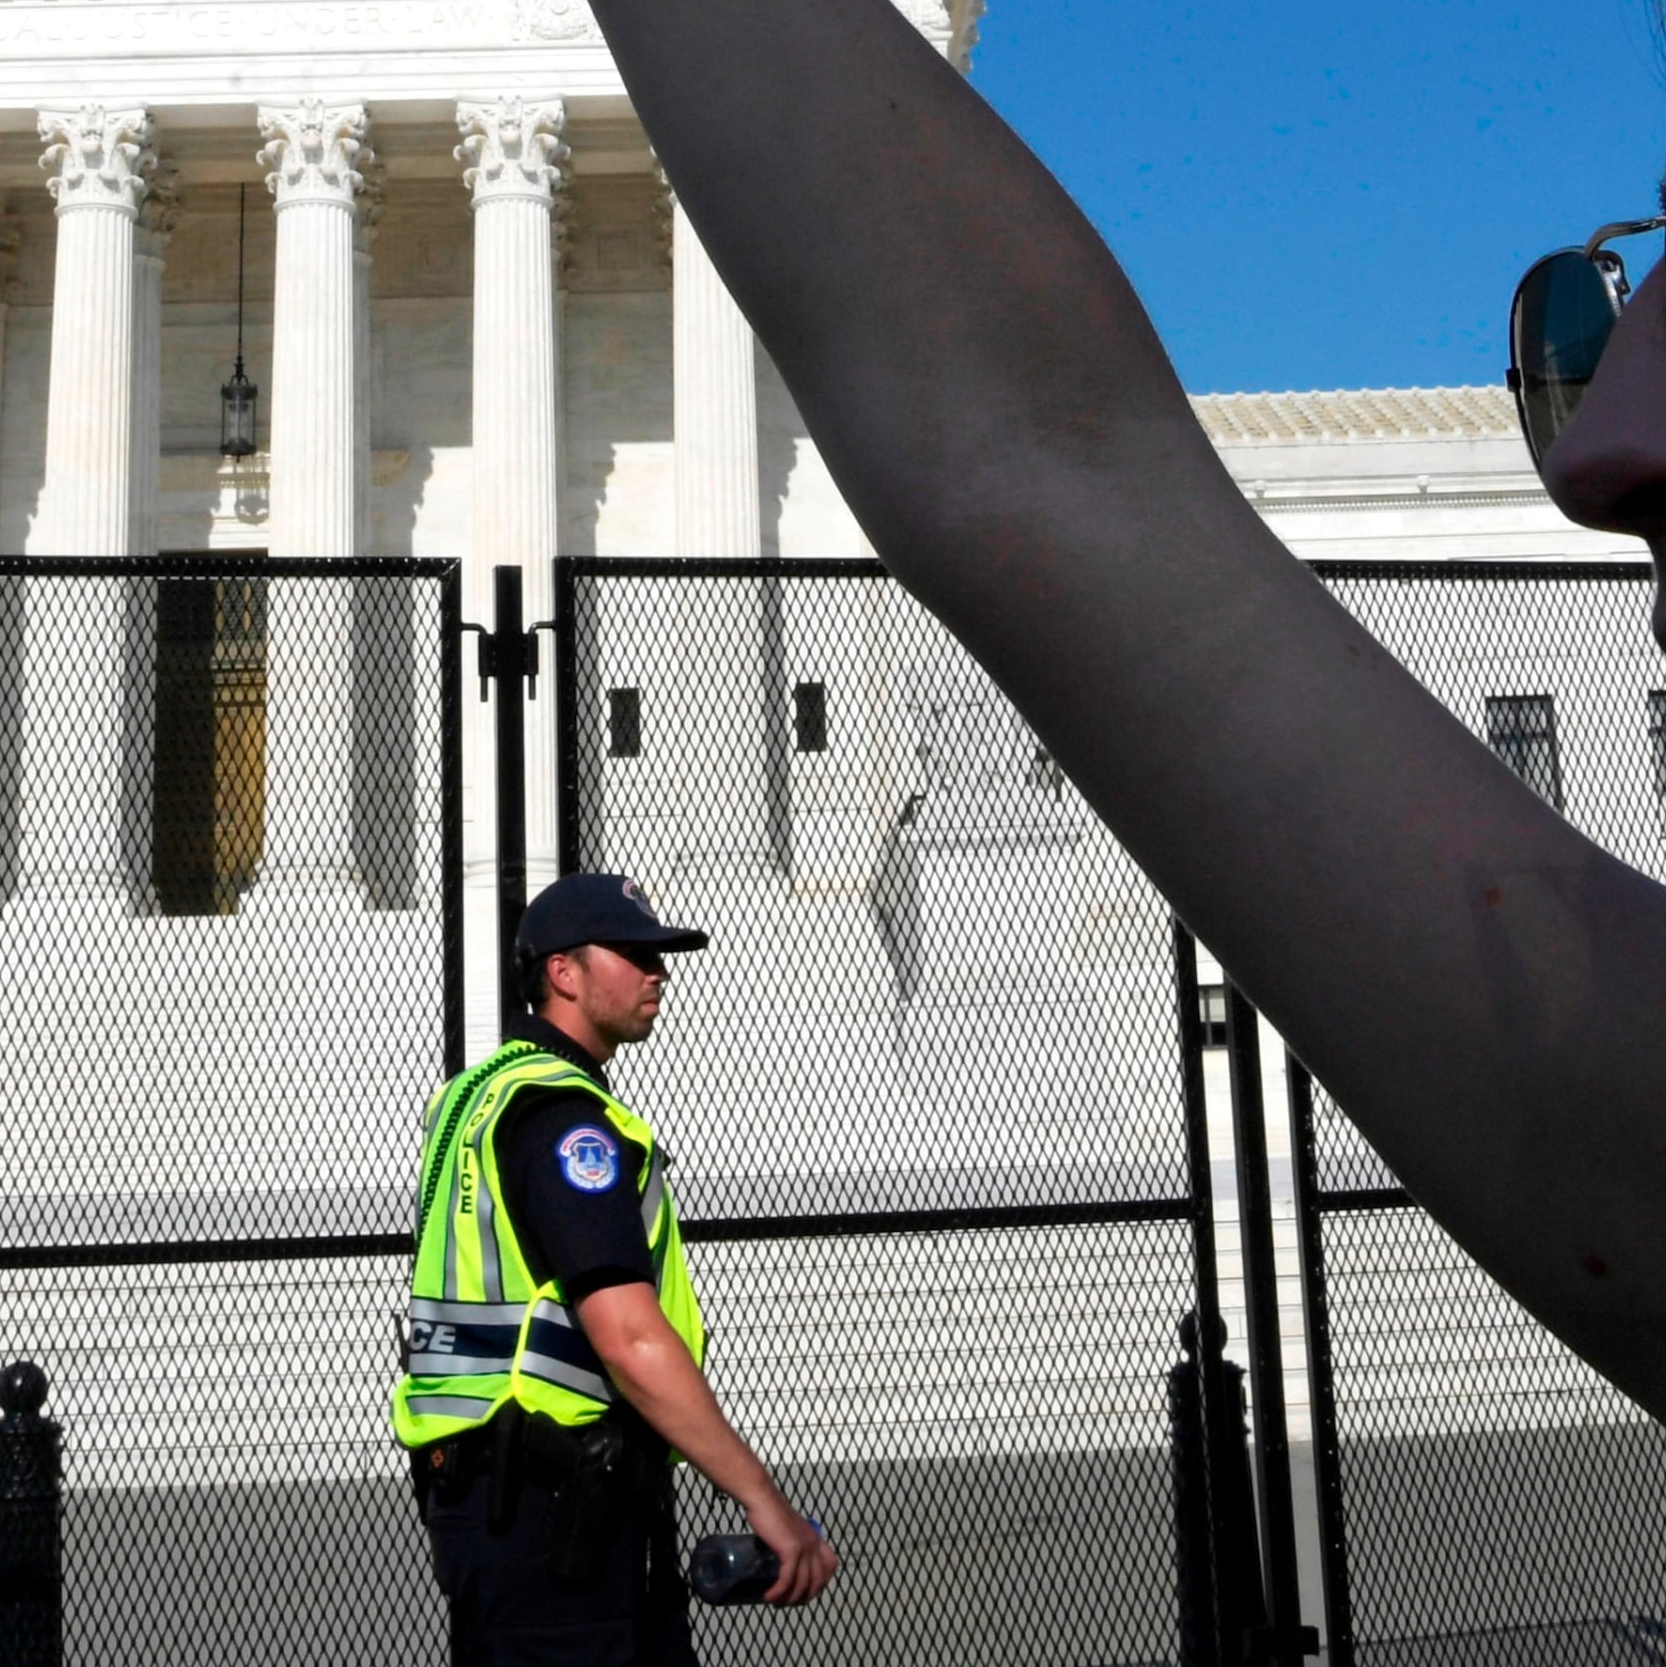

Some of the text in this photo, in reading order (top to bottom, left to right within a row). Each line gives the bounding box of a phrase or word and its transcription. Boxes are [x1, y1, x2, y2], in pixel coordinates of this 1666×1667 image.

[73, 10, 232, 41] JUSTICE
[254, 6, 389, 36] UNDER
[405, 4, 483, 33] LAW
[460, 1093, 495, 1214] POLICE
